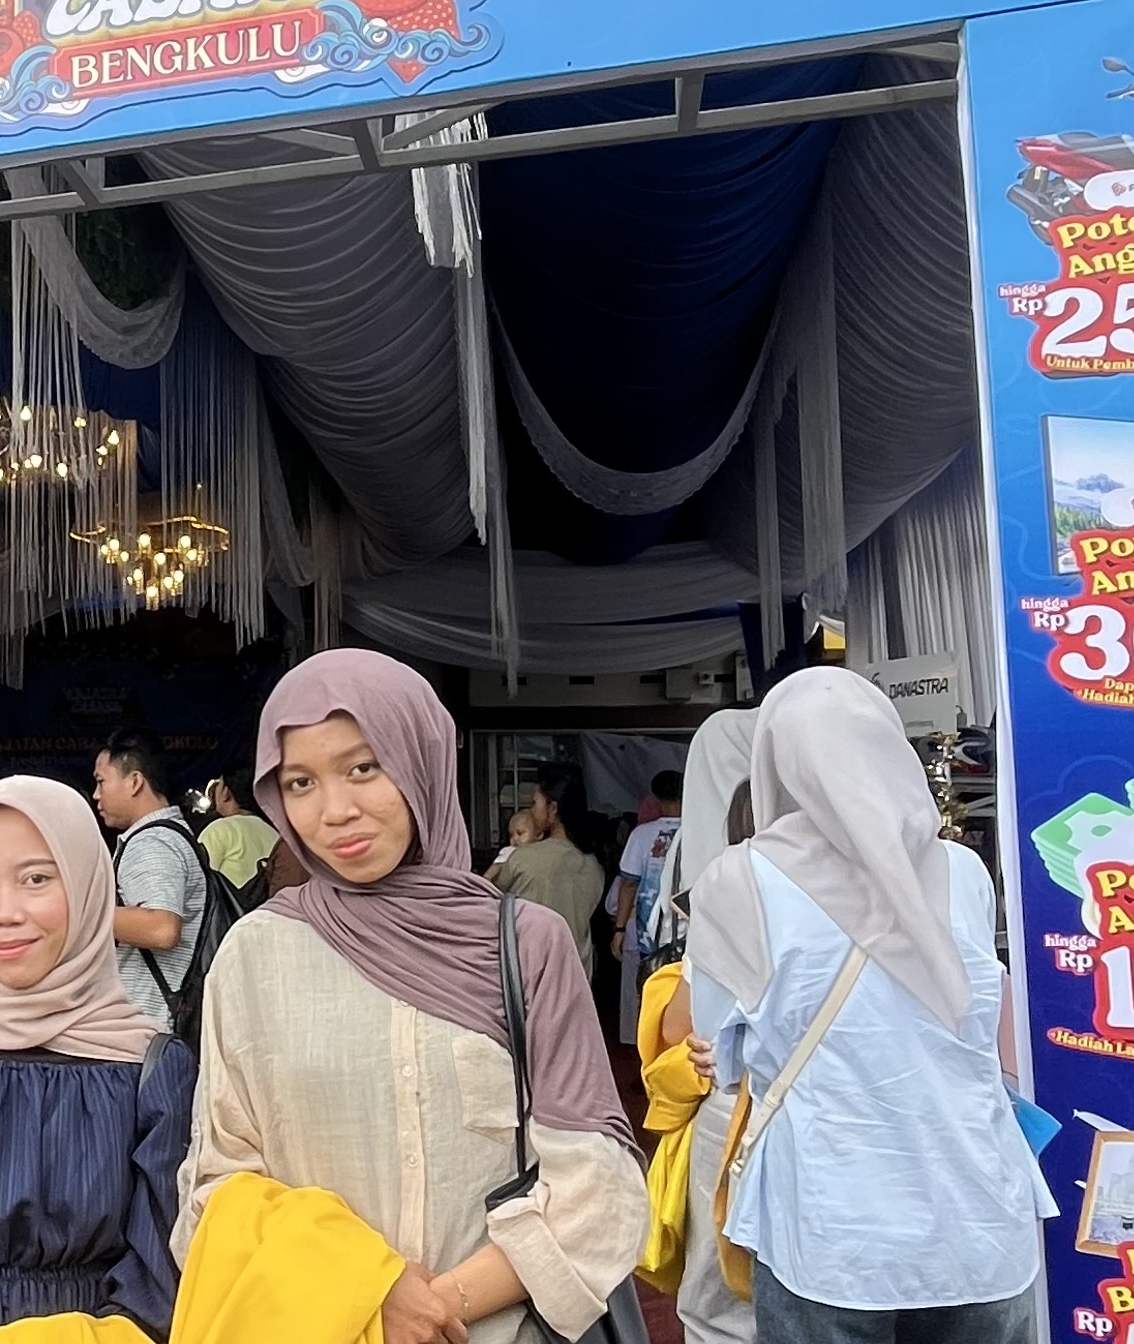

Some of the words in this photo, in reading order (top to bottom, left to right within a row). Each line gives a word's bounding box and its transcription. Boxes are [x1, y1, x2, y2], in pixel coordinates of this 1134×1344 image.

[71, 20, 303, 88] BENGKULU
[999, 283, 1047, 299] hingga
[1012, 297, 1044, 316] Rp
[1046, 355, 1090, 369] Untuk
[1021, 598, 1069, 612] hingga
[1033, 611, 1066, 630] Rp
[1059, 605, 1134, 681] 3
[889, 677, 949, 700] DANASTRA
[1044, 935, 1097, 951] hingga
[1058, 951, 1094, 972] Rp
[1077, 1310, 1113, 1337] Rp
